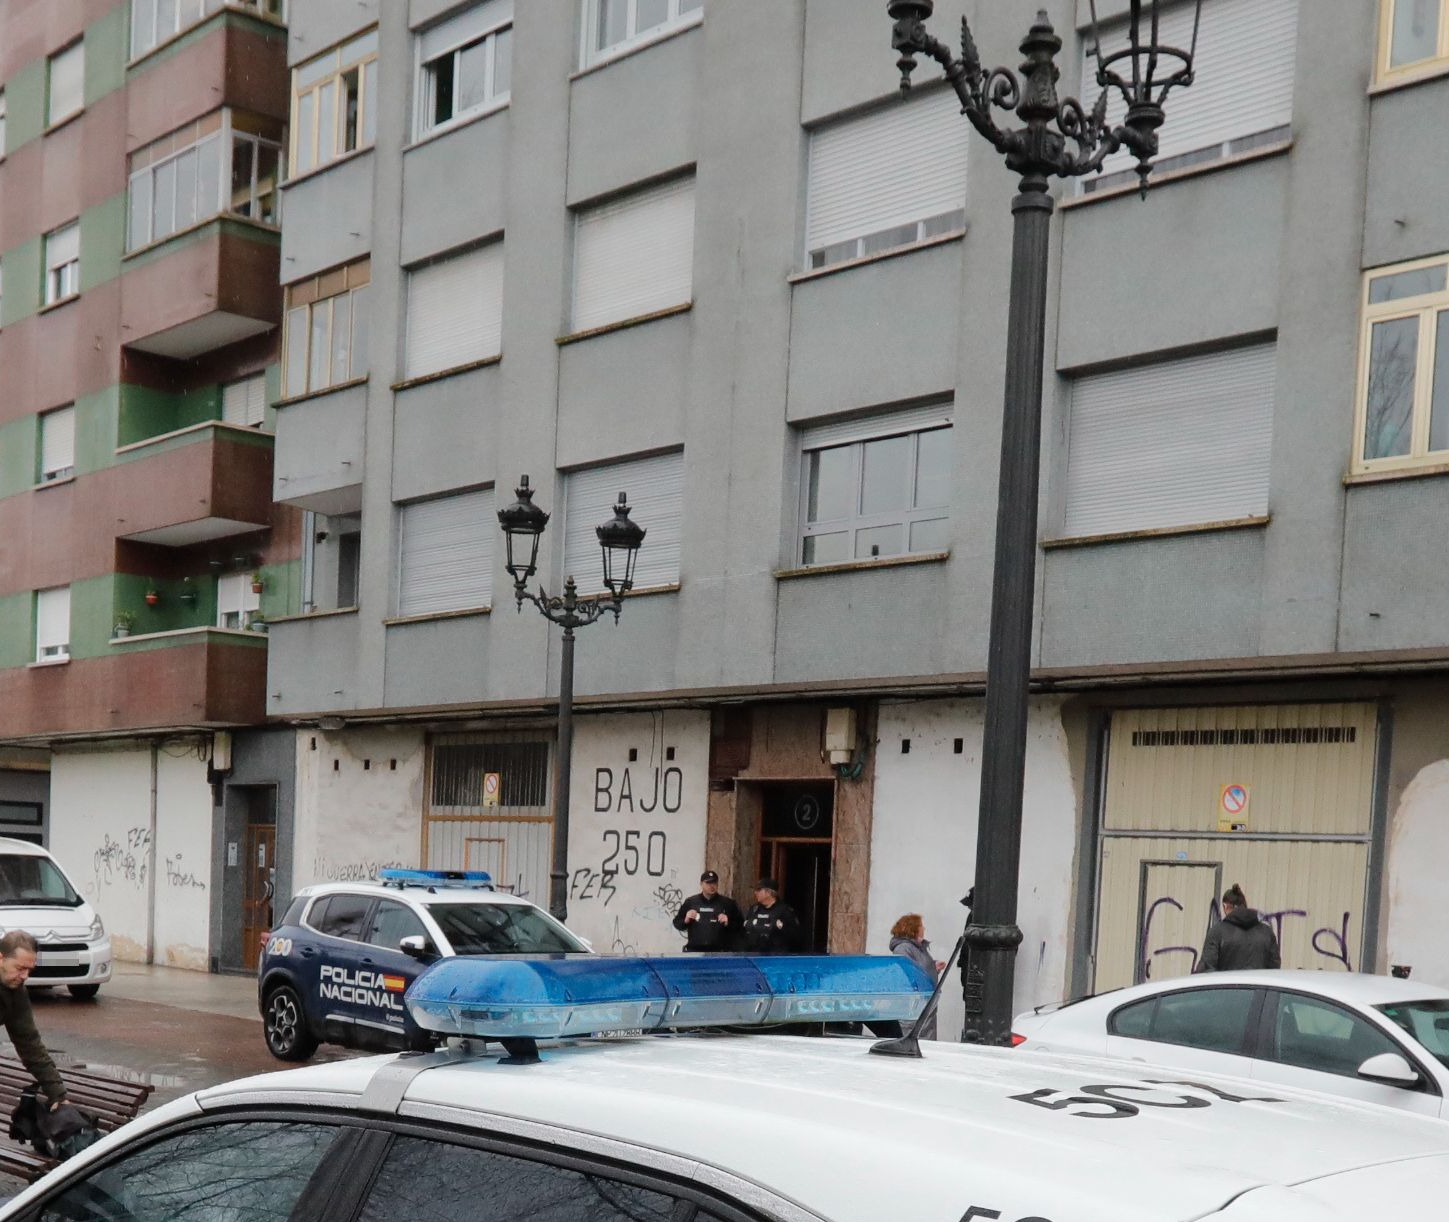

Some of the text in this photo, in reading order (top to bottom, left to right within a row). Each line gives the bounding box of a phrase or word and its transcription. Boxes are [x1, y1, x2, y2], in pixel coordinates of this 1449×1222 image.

[593, 766, 683, 814] BAJO
[802, 804, 811, 821] 2
[602, 830, 667, 876] 250
[320, 982, 404, 1011] NACIONAL
